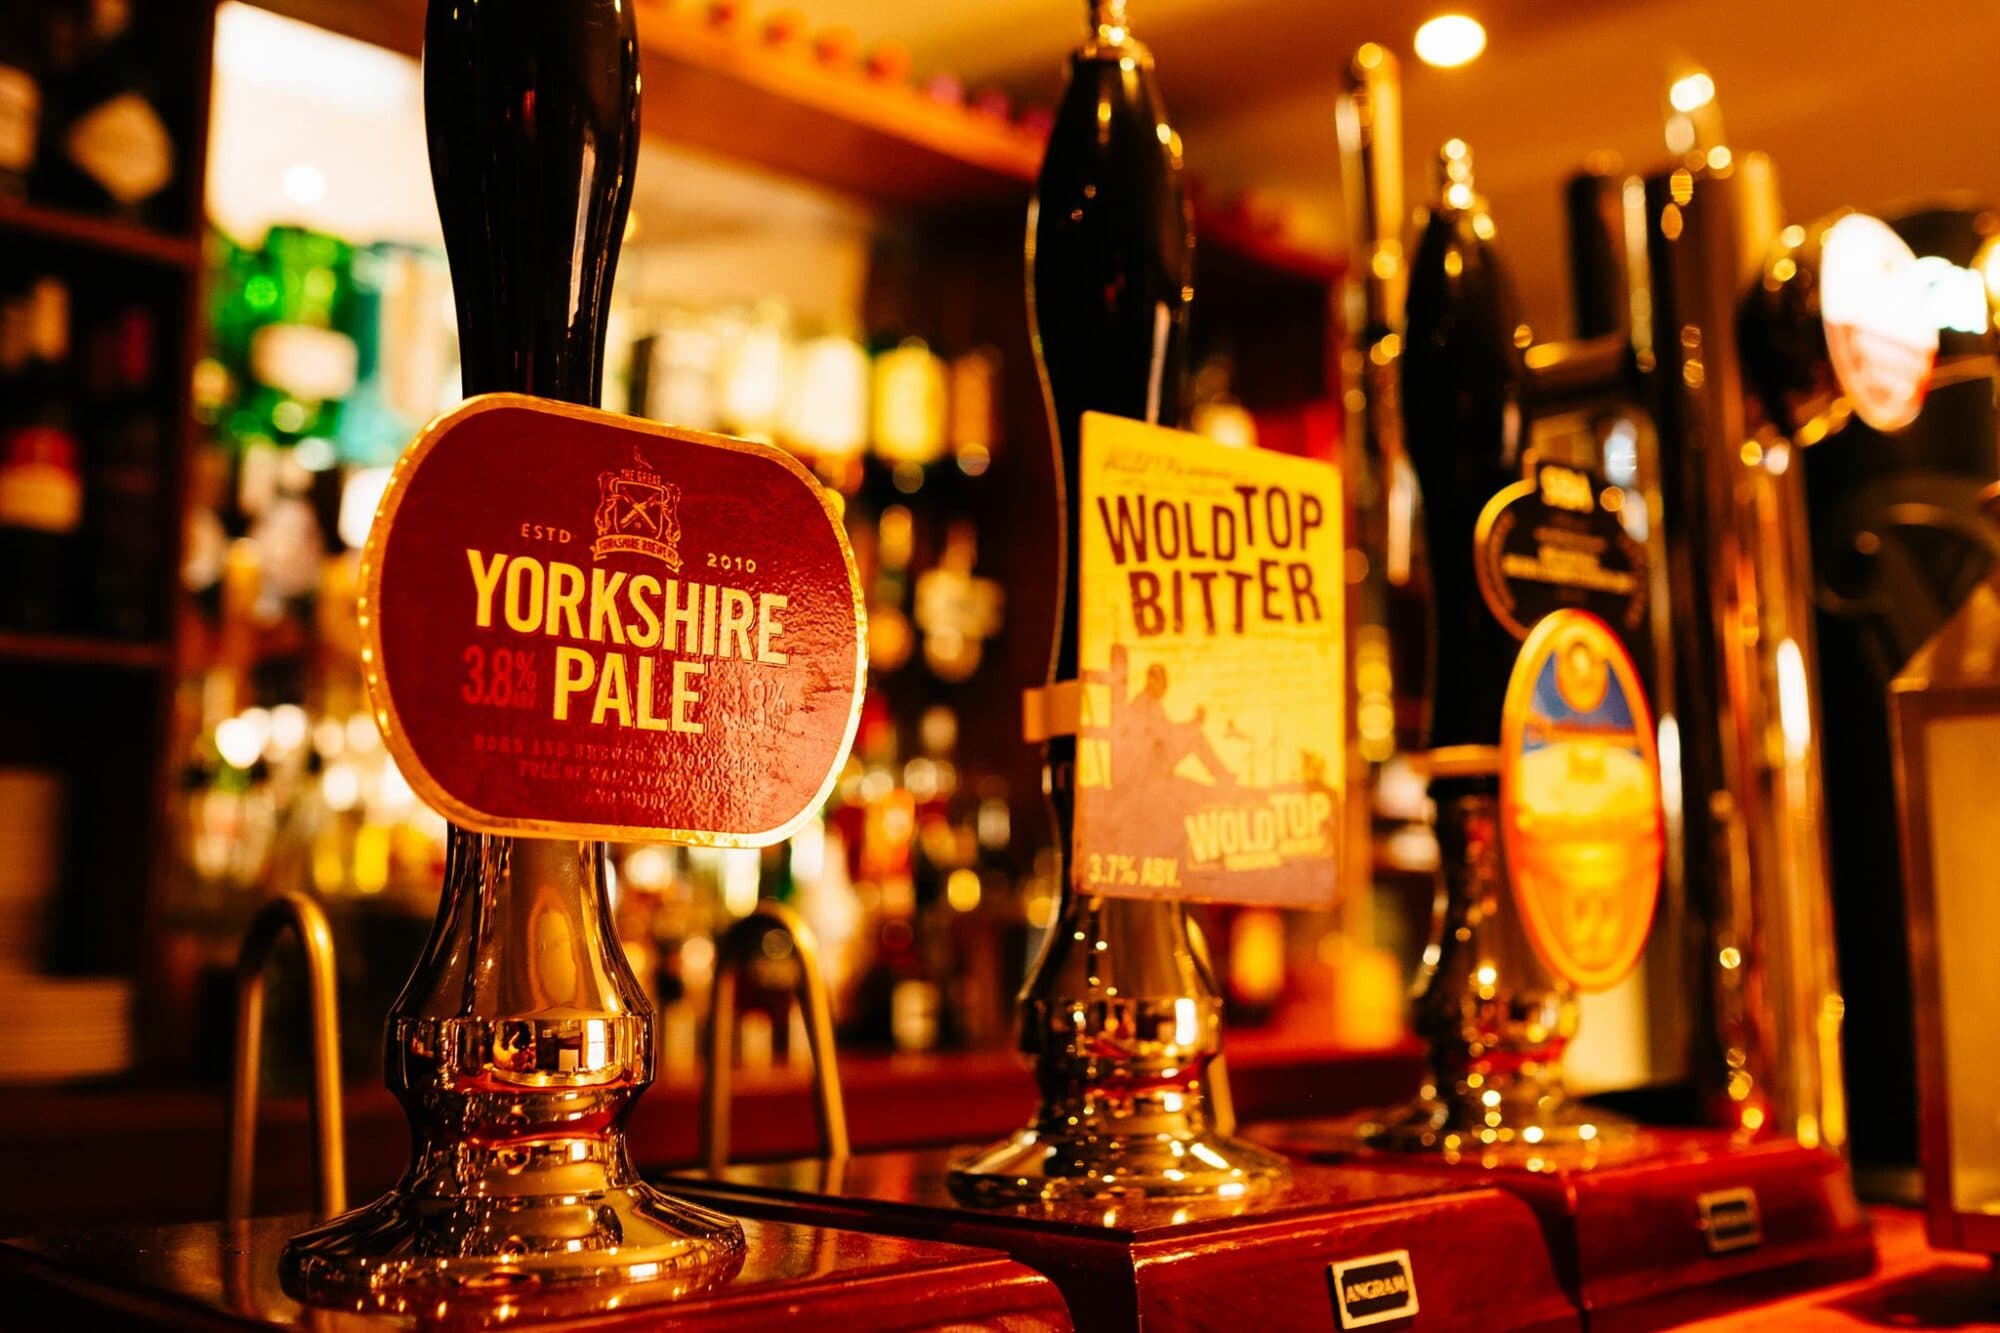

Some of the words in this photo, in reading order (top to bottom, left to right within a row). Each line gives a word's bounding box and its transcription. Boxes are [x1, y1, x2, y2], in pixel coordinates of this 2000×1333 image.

[520, 522, 572, 544] ESTD
[706, 552, 757, 574] 2010
[466, 548, 789, 666] YORKSHIRE
[1128, 558, 1322, 637] BITTER
[461, 643, 538, 706] 3.8%
[552, 646, 706, 734] PALE
[1088, 853, 1139, 885] 3.7%
